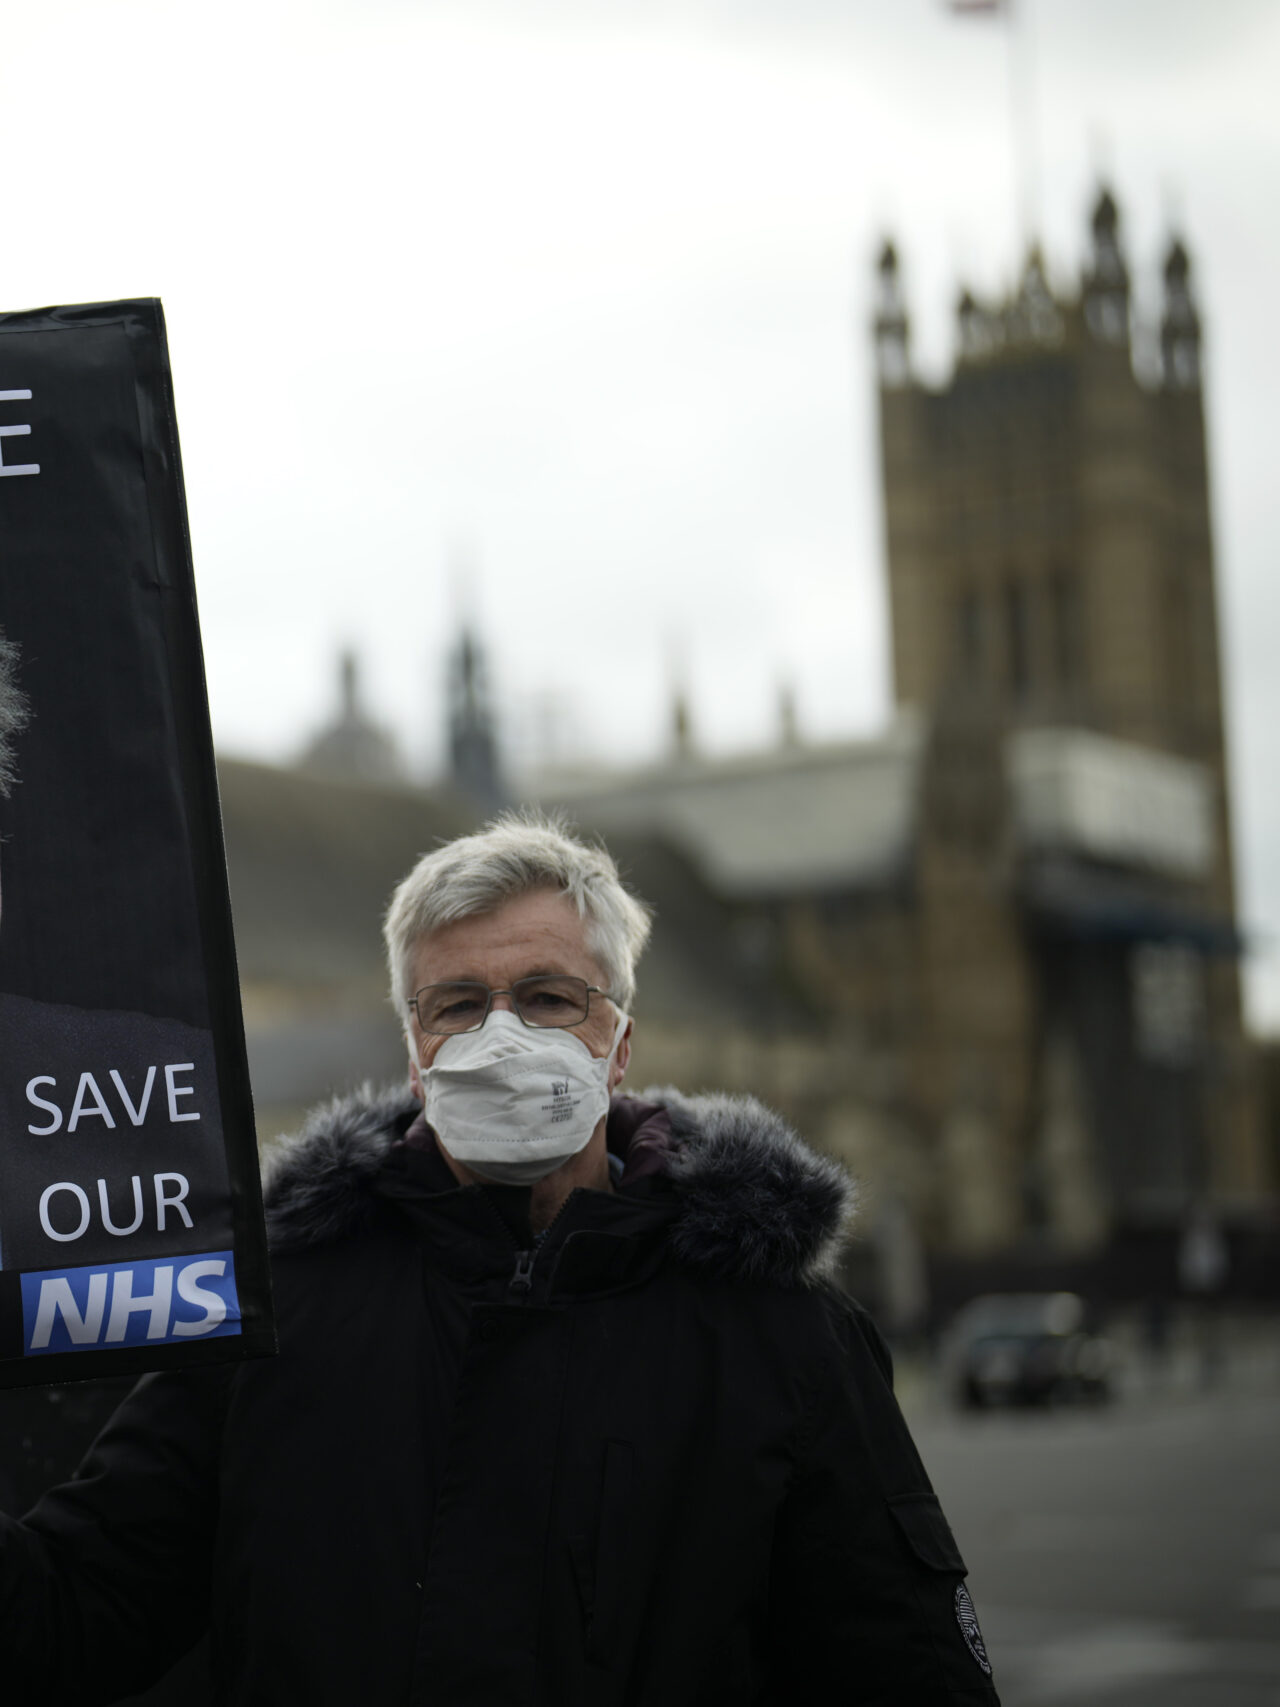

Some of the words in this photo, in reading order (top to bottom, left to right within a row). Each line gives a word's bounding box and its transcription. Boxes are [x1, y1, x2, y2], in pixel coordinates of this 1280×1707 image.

[25, 1062, 201, 1136] SAVE
[38, 1172, 194, 1242] OUR
[29, 1259, 229, 1348] NHS
